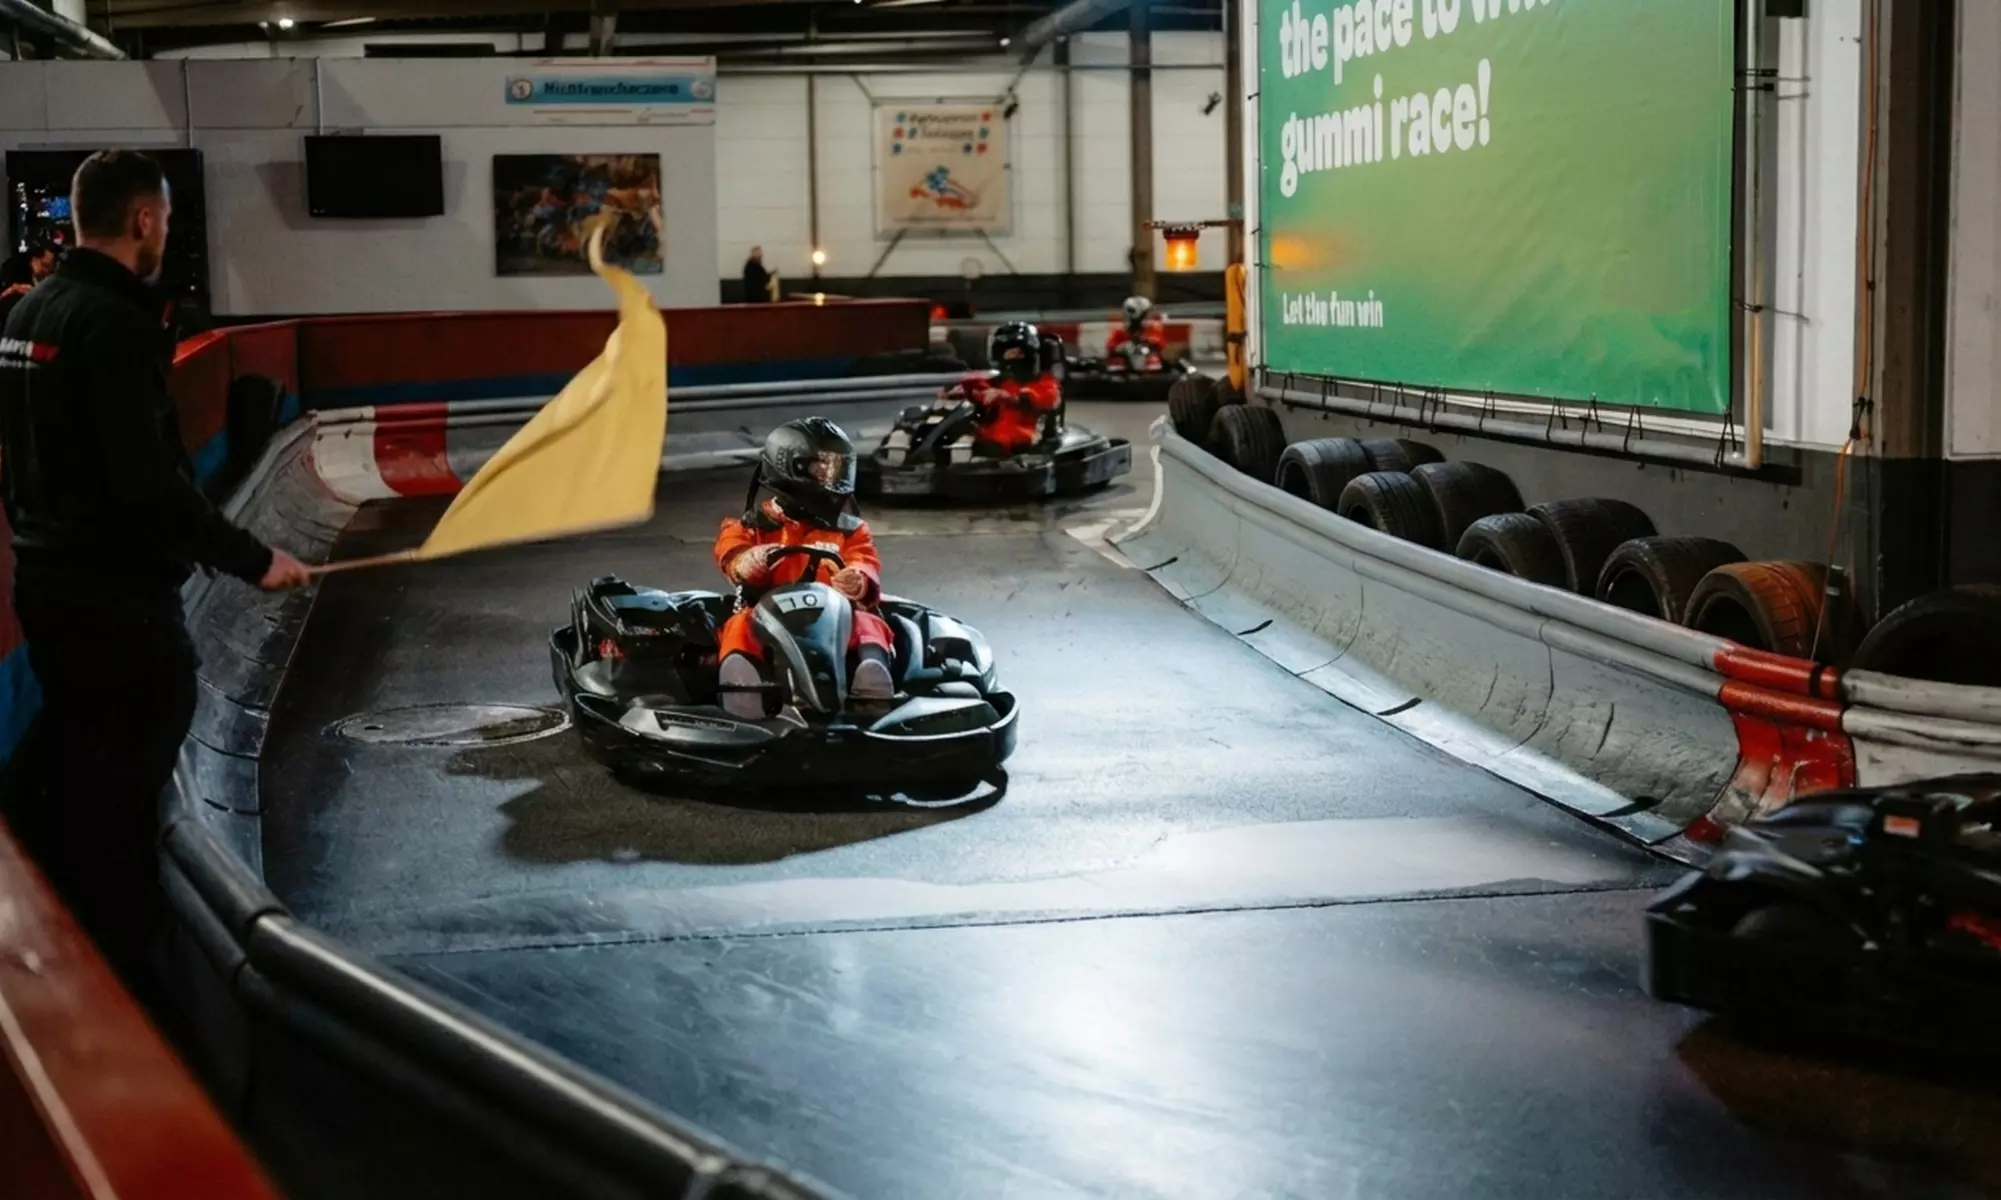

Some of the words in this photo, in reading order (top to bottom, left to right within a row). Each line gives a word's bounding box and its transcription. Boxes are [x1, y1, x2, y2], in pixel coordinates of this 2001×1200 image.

[1280, 0, 1328, 78] the
[1333, 0, 1412, 85] pace
[1280, 73, 1383, 198] gummi
[1390, 58, 1491, 160] race!
[1283, 292, 1303, 324] Let
[1331, 291, 1355, 327] fun
[1356, 289, 1383, 328] win
